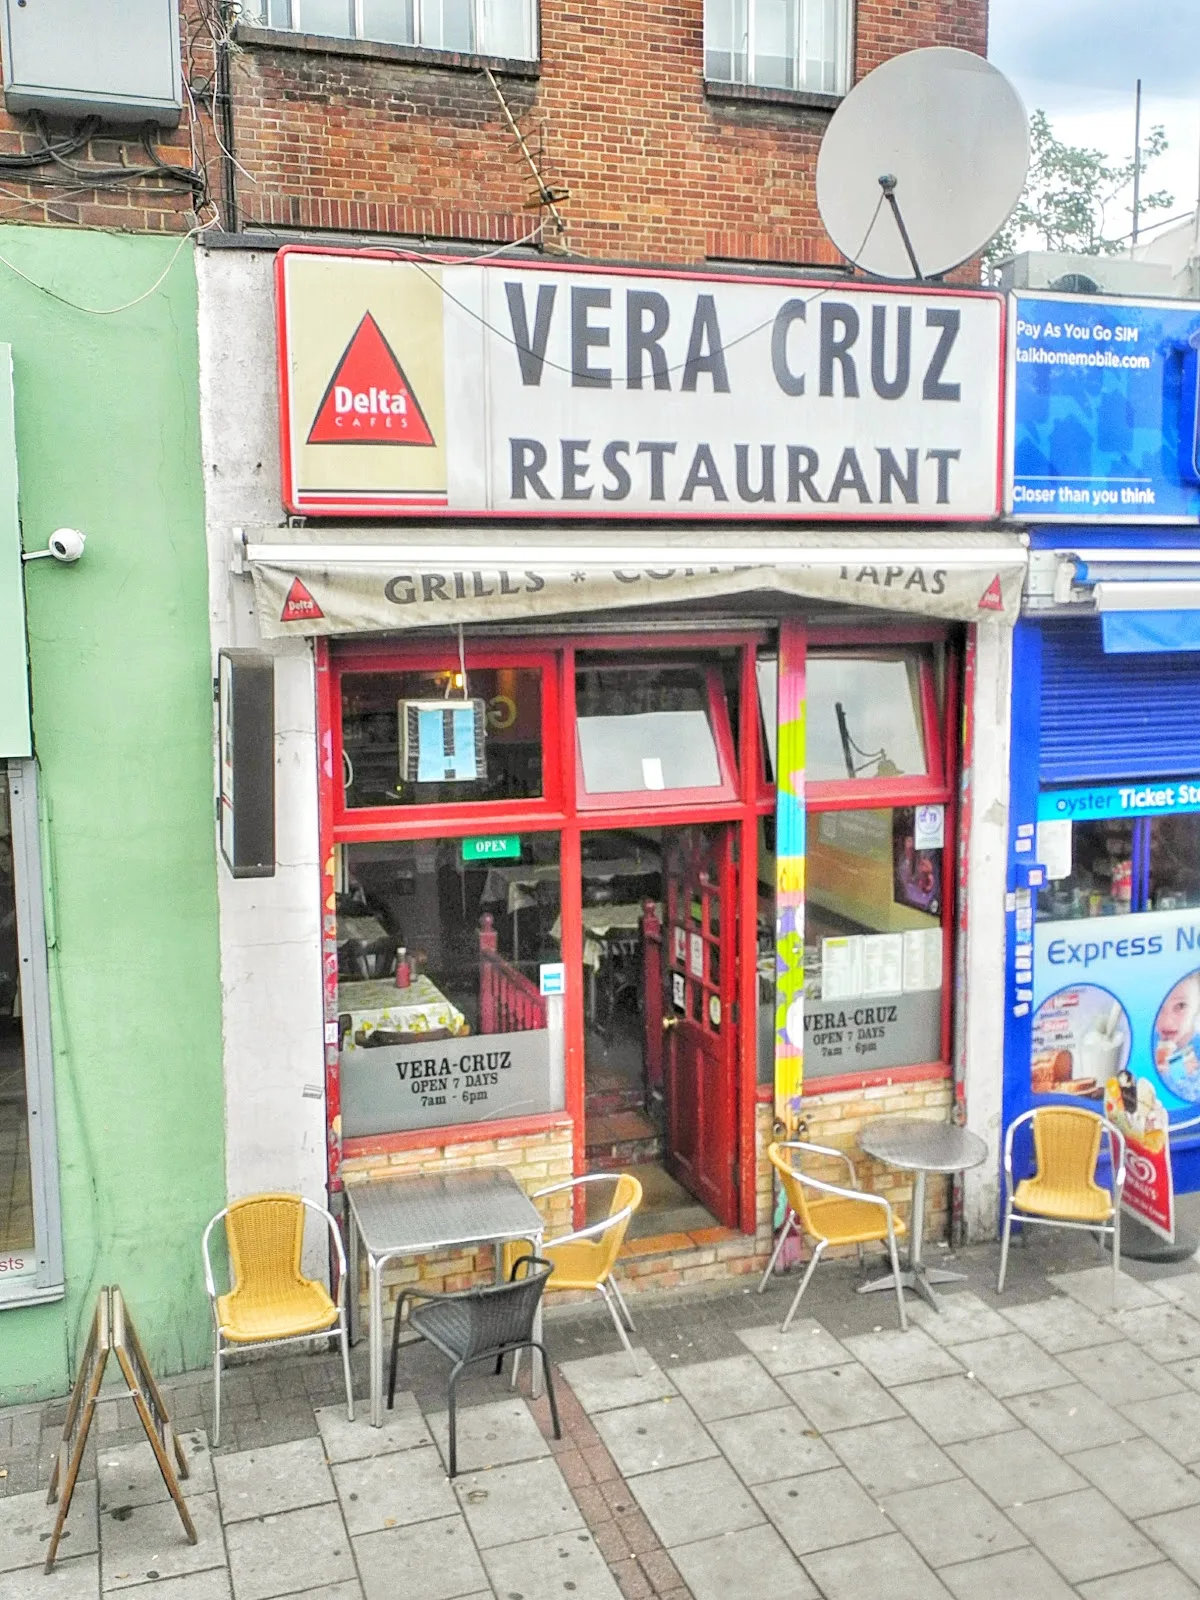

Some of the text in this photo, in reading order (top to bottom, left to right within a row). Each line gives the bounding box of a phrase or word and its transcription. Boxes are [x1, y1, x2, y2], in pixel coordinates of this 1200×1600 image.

[503, 281, 962, 402] VERA CRUZ
[1016, 320, 1139, 342] Pay As You Go SIM
[1016, 347, 1150, 369] talkhomemobile.com
[334, 385, 407, 415] Delta
[508, 437, 961, 505] RESTAURANT
[1012, 485, 1156, 506] Closer than you think
[384, 571, 545, 605] GRILLS
[1056, 793, 1113, 815] oyster
[1119, 788, 1176, 809] Ticket
[475, 840, 507, 853] OPEN
[1047, 936, 1163, 968] Express
[1176, 926, 1200, 951] N
[803, 1005, 898, 1031] VERA-CRUZ
[813, 1031, 844, 1046] OPEN
[858, 1026, 886, 1041] DAYS
[396, 1051, 512, 1080] VERA-CRUZ
[411, 1072, 498, 1094] OPEN 7 DAYS
[421, 1096, 446, 1107] 7am
[462, 1090, 488, 1104] 6pm
